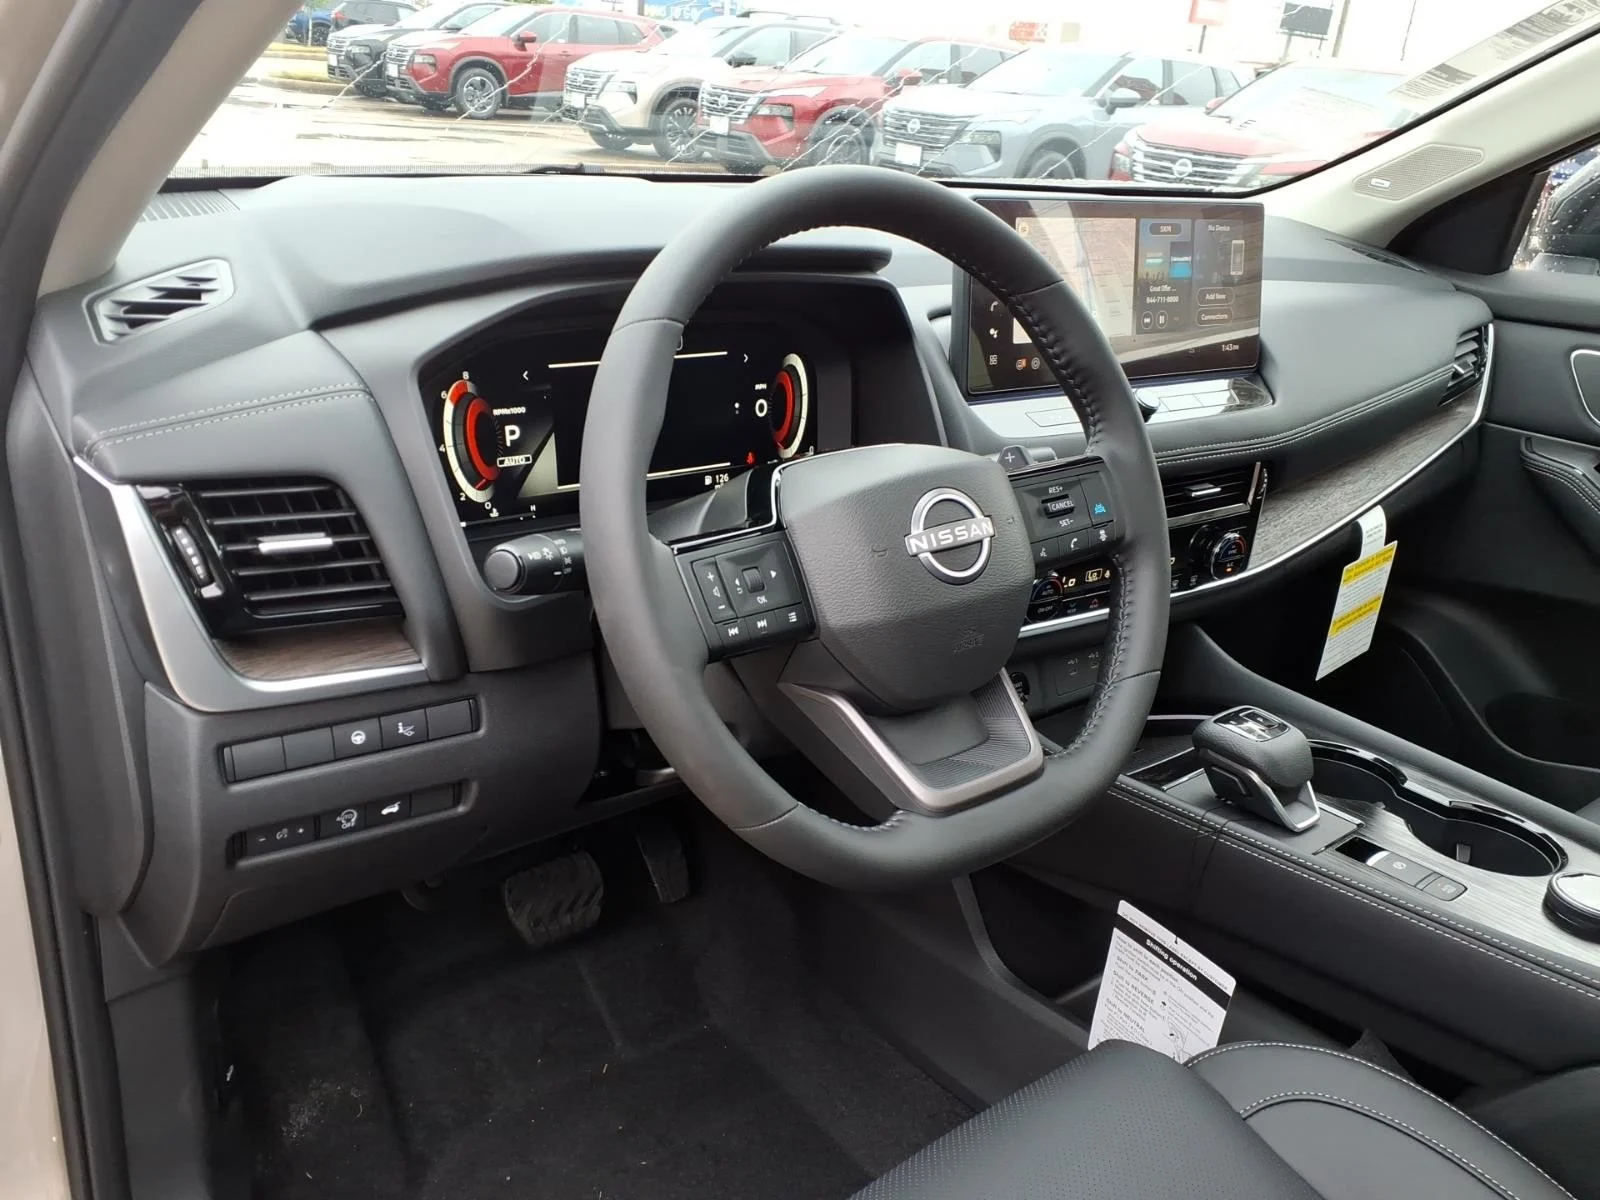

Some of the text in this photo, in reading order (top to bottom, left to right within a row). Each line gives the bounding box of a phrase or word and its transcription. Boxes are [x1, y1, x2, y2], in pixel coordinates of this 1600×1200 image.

[1205, 292, 1216, 300] Add
[463, 371, 469, 380] 8
[441, 390, 447, 399] 6
[504, 425, 521, 447] P
[439, 444, 446, 452] 4
[504, 456, 526, 465] AUTO
[715, 473, 729, 483] 126
[1048, 485, 1063, 494] RES+
[460, 493, 466, 501] 2
[484, 501, 492, 510] 0
[1051, 500, 1074, 511] CANCEL
[909, 522, 994, 553] NISSAN
[756, 595, 768, 605] OK
[1146, 939, 1169, 960] Shifting
[1169, 957, 1198, 981] operation
